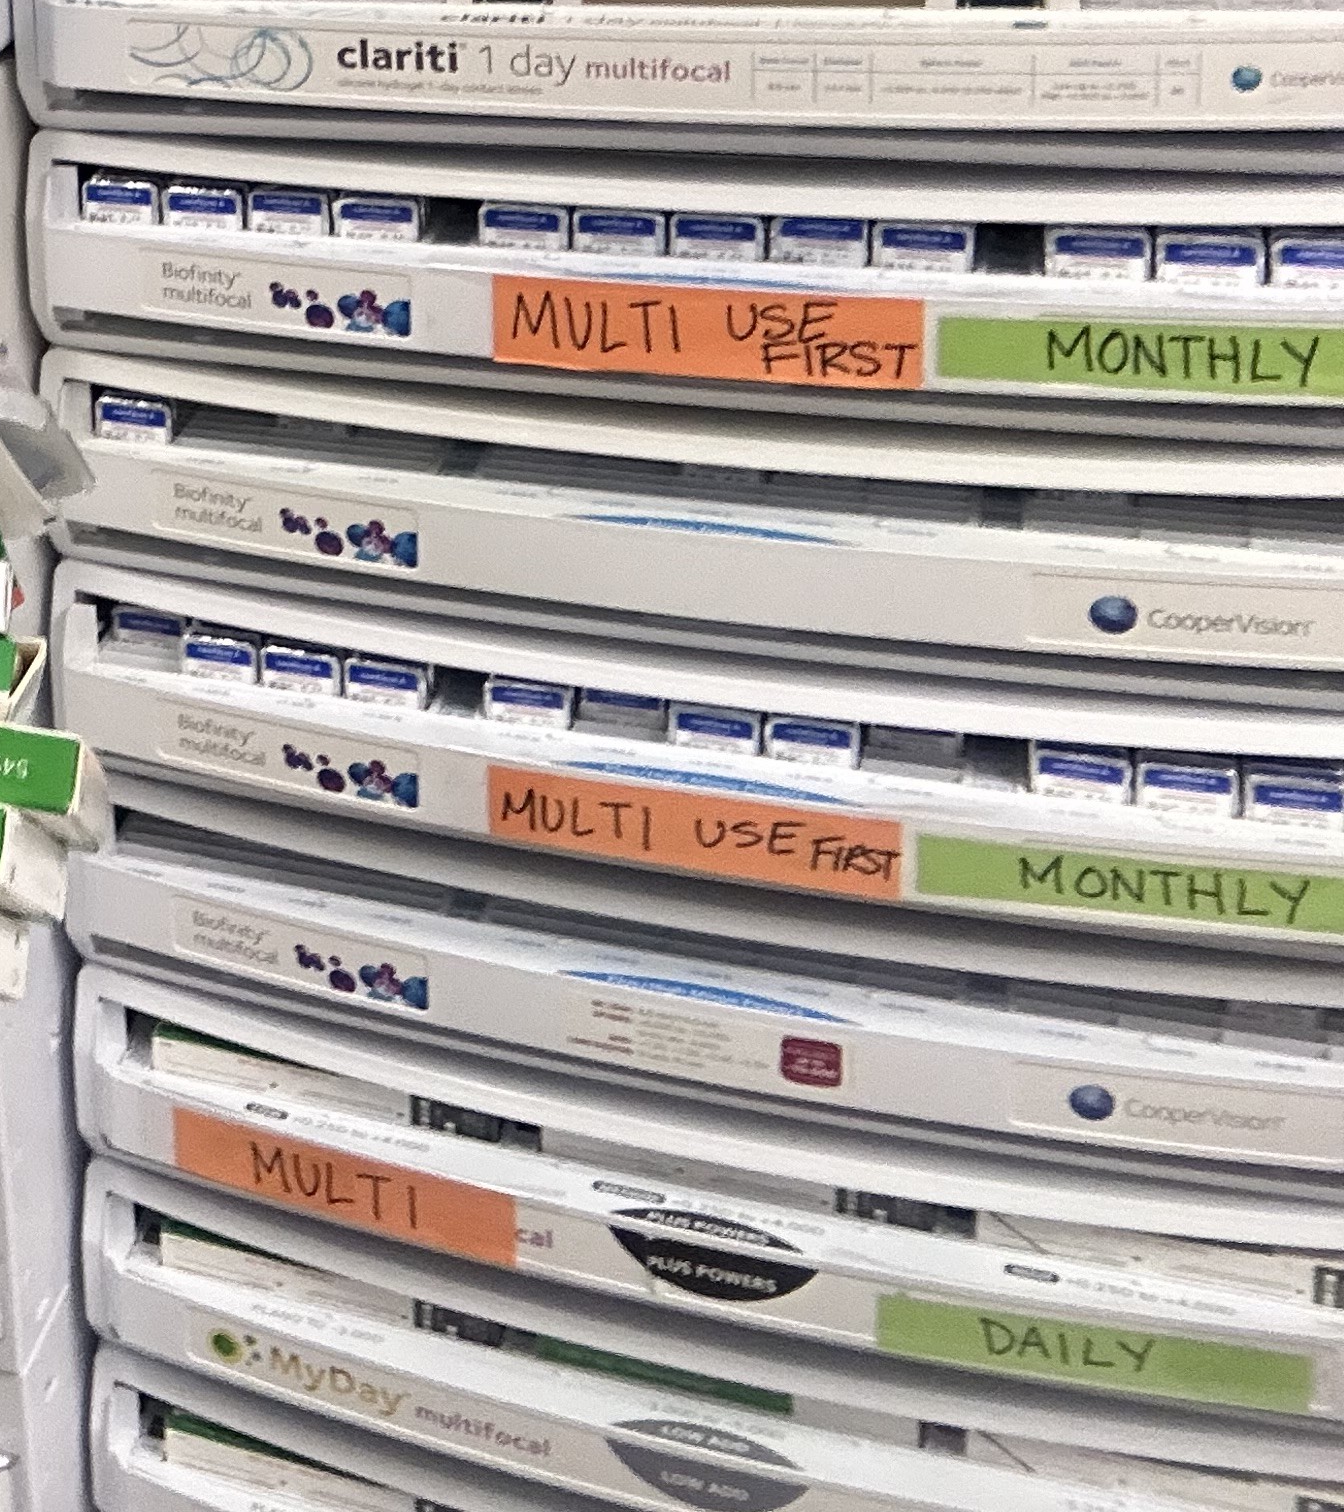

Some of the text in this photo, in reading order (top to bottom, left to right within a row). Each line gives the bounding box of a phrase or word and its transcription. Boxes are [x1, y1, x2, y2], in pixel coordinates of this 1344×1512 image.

[336, 38, 459, 74] clariti
[478, 44, 494, 75] 1
[510, 44, 577, 87] day
[585, 58, 731, 83] multifocal
[162, 261, 238, 290] Biofinity
[162, 285, 252, 310] multifocal
[511, 291, 837, 354] MULTI USE
[762, 338, 918, 380] FIRST
[1047, 324, 1319, 388] MONTHLY
[173, 482, 248, 513] Biofinity
[175, 505, 262, 533] multifocal
[1147, 607, 1311, 640] CooperVision
[501, 789, 900, 882] MULTI USE FIRST
[1019, 855, 1310, 925] MONTHLY
[249, 1140, 418, 1230] MULTI
[645, 1255, 779, 1294] PLUS POWERS
[978, 1315, 1156, 1373] DAILY
[268, 1345, 403, 1418] MyDay
[414, 1404, 551, 1457] multifocal
